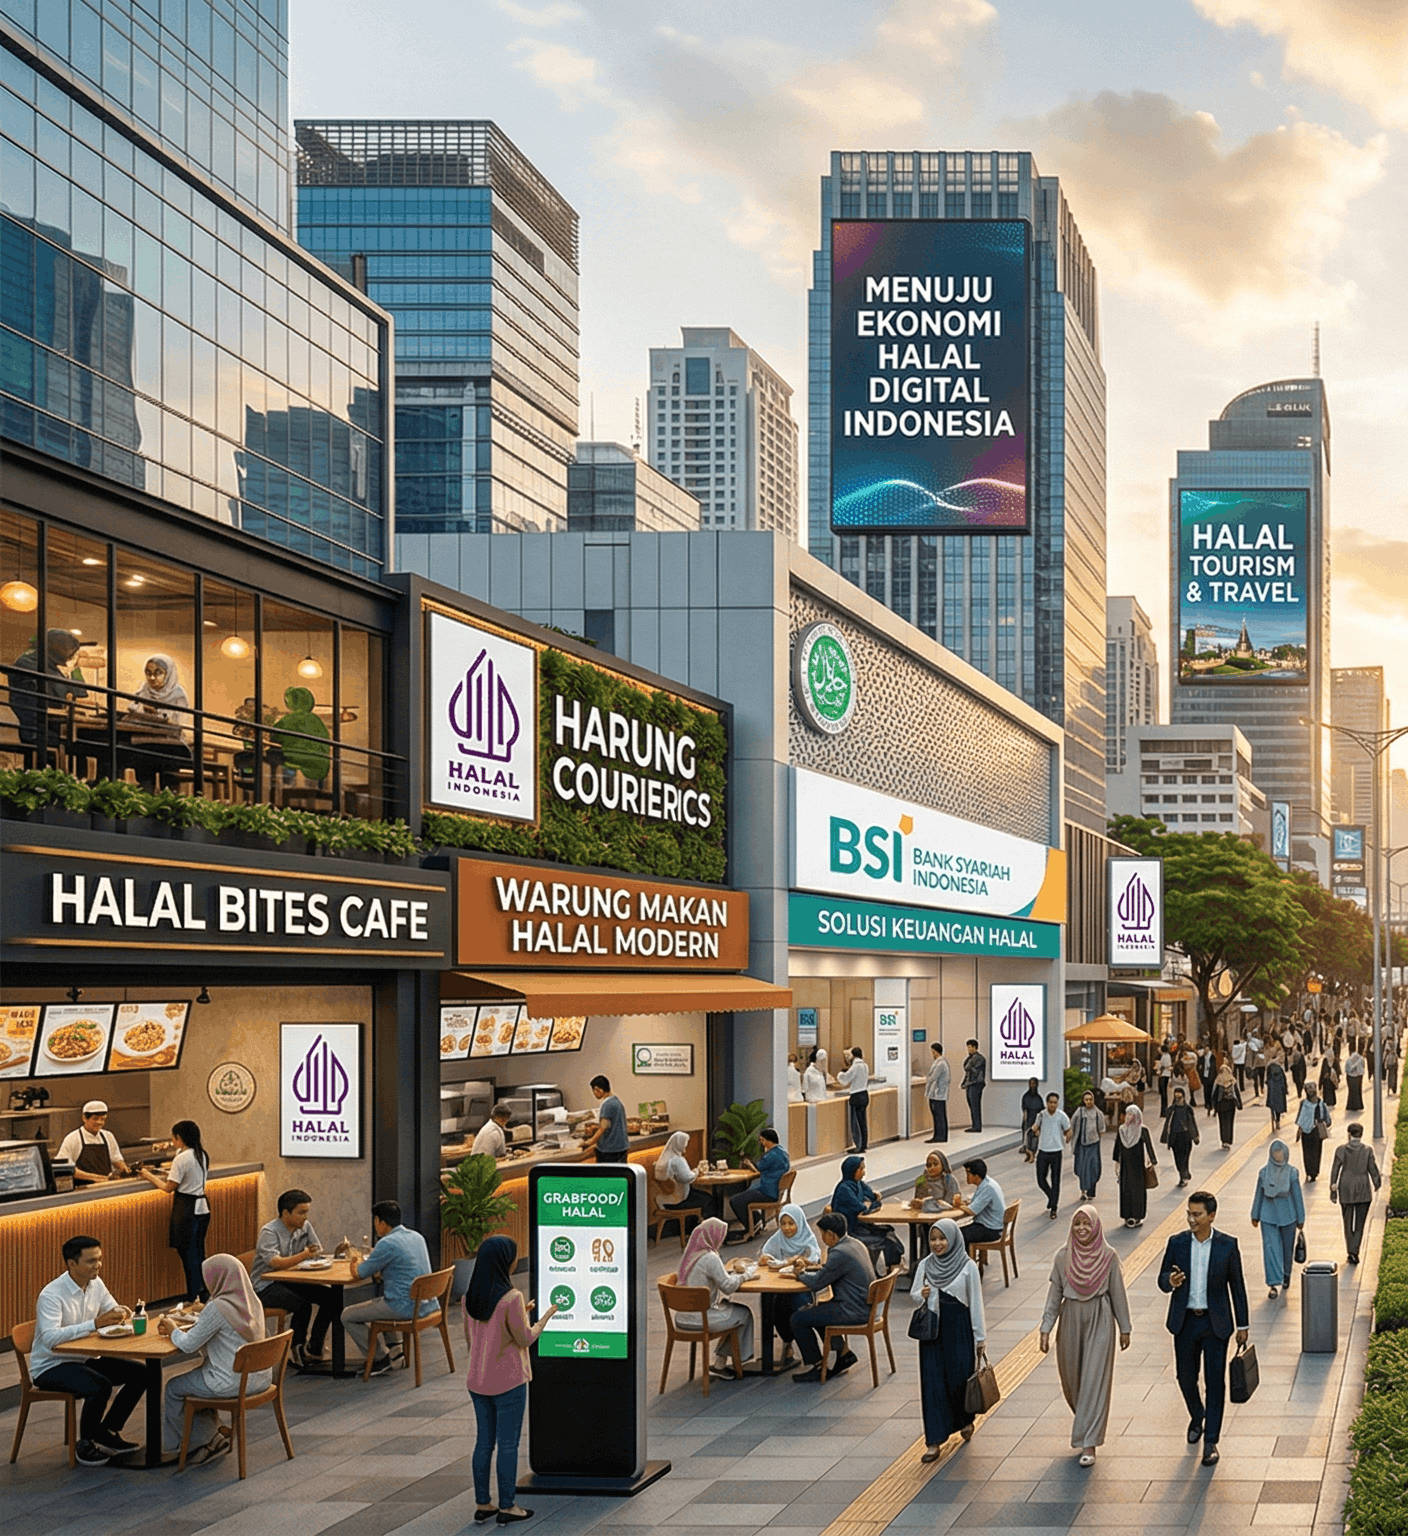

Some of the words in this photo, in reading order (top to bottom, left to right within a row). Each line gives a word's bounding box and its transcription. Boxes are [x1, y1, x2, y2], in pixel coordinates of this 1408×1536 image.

[866, 277, 992, 303] MENUJU
[857, 311, 1001, 337] EKONOMI
[878, 344, 980, 370] HALAL
[869, 377, 990, 403] DIGITAL
[844, 410, 1015, 437] INDONESIA
[1193, 524, 1294, 550] HALAL
[1189, 555, 1295, 576] TOURISM
[1186, 582, 1202, 602] &
[1209, 582, 1299, 602] TRAVEL
[555, 694, 696, 780] HARUNG
[449, 760, 520, 790] HALAL
[448, 781, 520, 802] INDONESIA
[553, 756, 712, 828] COURIERICS
[830, 815, 903, 883] BSI
[913, 848, 954, 872] BANK
[955, 856, 1011, 881] SYARIAH
[913, 869, 989, 896] INDONESIA
[51, 873, 206, 930] HALAL
[218, 885, 329, 937] BITES
[339, 895, 429, 940] CAFE
[496, 876, 631, 920] WARUNG
[640, 892, 727, 927] MAKAN
[513, 919, 608, 955] HALAL
[615, 925, 719, 959] MODERN
[818, 910, 887, 937] SOLUSI
[892, 918, 984, 944] KEUANGAN
[989, 927, 1038, 949] HALAL
[1117, 934, 1155, 943] HALAL
[1000, 1050, 1035, 1060] HALAL
[292, 1120, 350, 1133] HALAL
[543, 1192, 625, 1206] GRABFOOD/
[562, 1207, 606, 1218] HALAL
